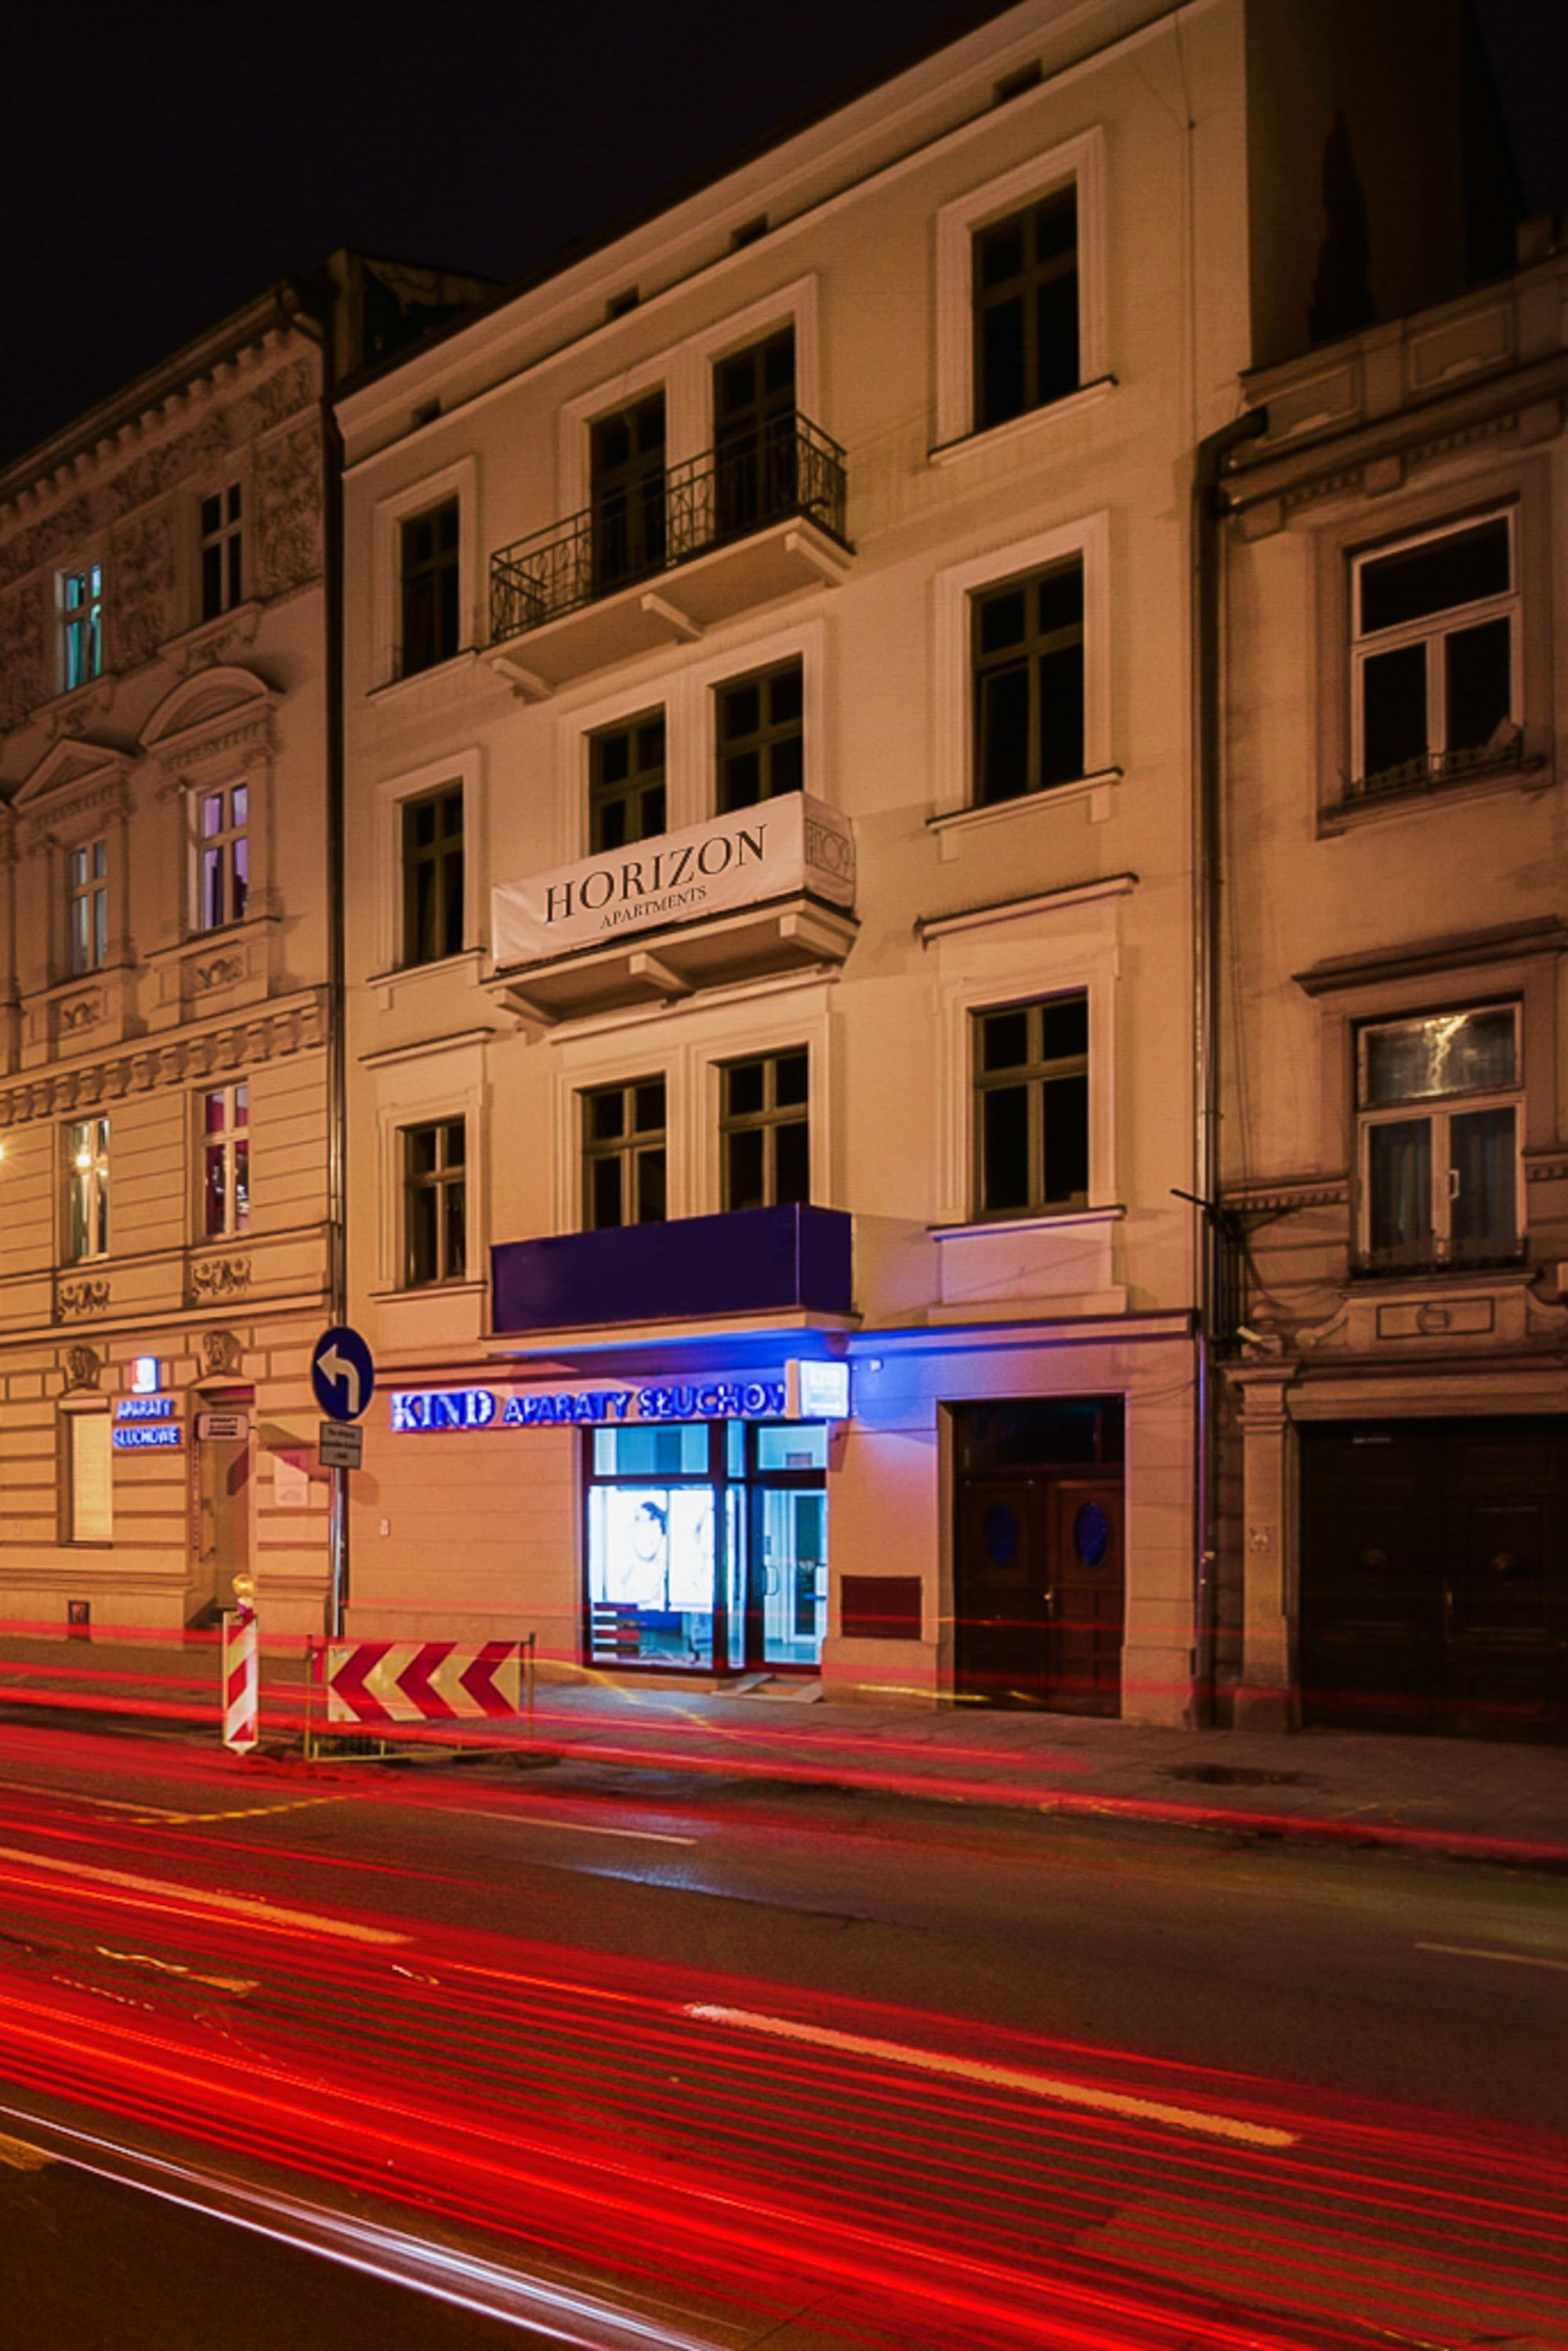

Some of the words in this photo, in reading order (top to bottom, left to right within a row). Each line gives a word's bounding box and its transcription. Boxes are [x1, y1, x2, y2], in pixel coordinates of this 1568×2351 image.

[544, 824, 767, 925] HORIZON
[600, 885, 707, 929] APARTMENTS
[391, 1390, 495, 1430] KIND
[504, 1390, 632, 1424] APARATY
